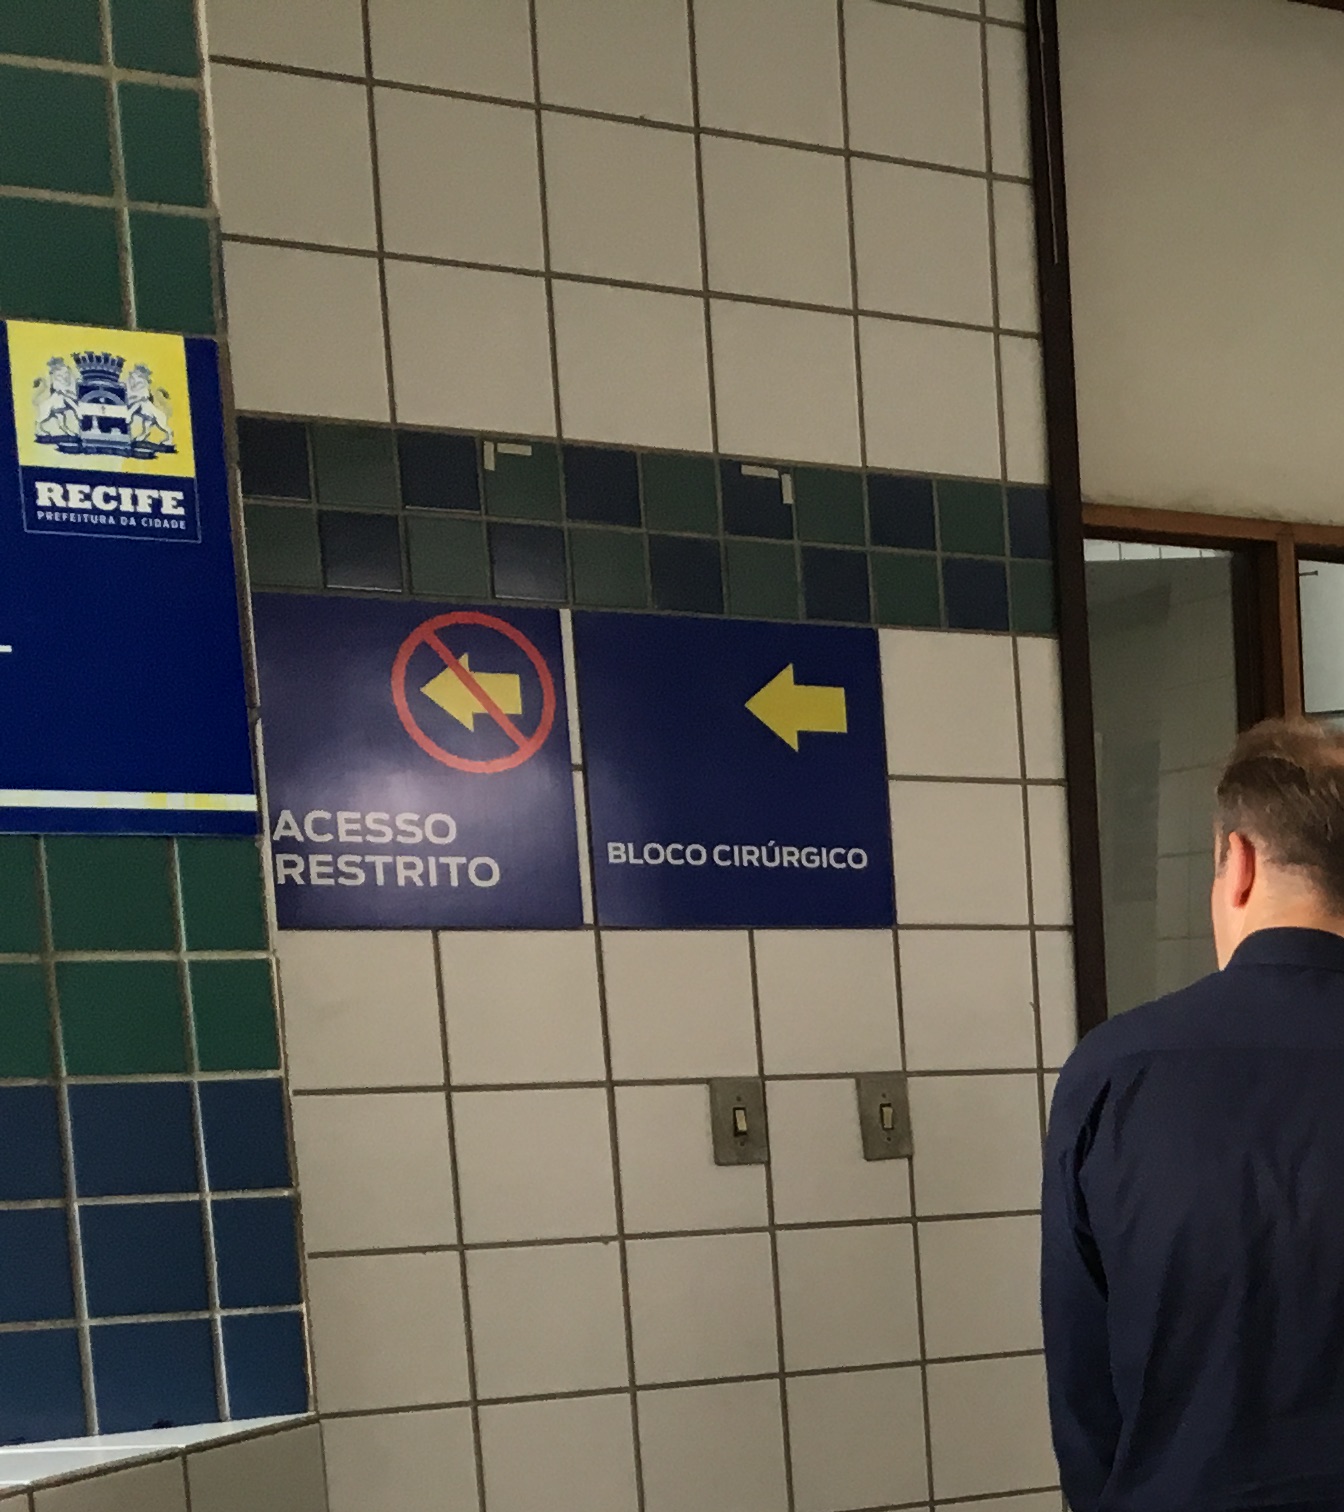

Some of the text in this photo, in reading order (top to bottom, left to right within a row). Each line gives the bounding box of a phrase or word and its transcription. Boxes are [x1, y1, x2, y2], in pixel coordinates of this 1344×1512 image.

[35, 481, 185, 515] RECIFE
[37, 510, 186, 530] PREFEITURA DA CIDADE
[273, 809, 457, 845] ACESSO
[275, 853, 500, 888] RESTRITO
[607, 840, 868, 869] BLOCO CIRÚRGICO
